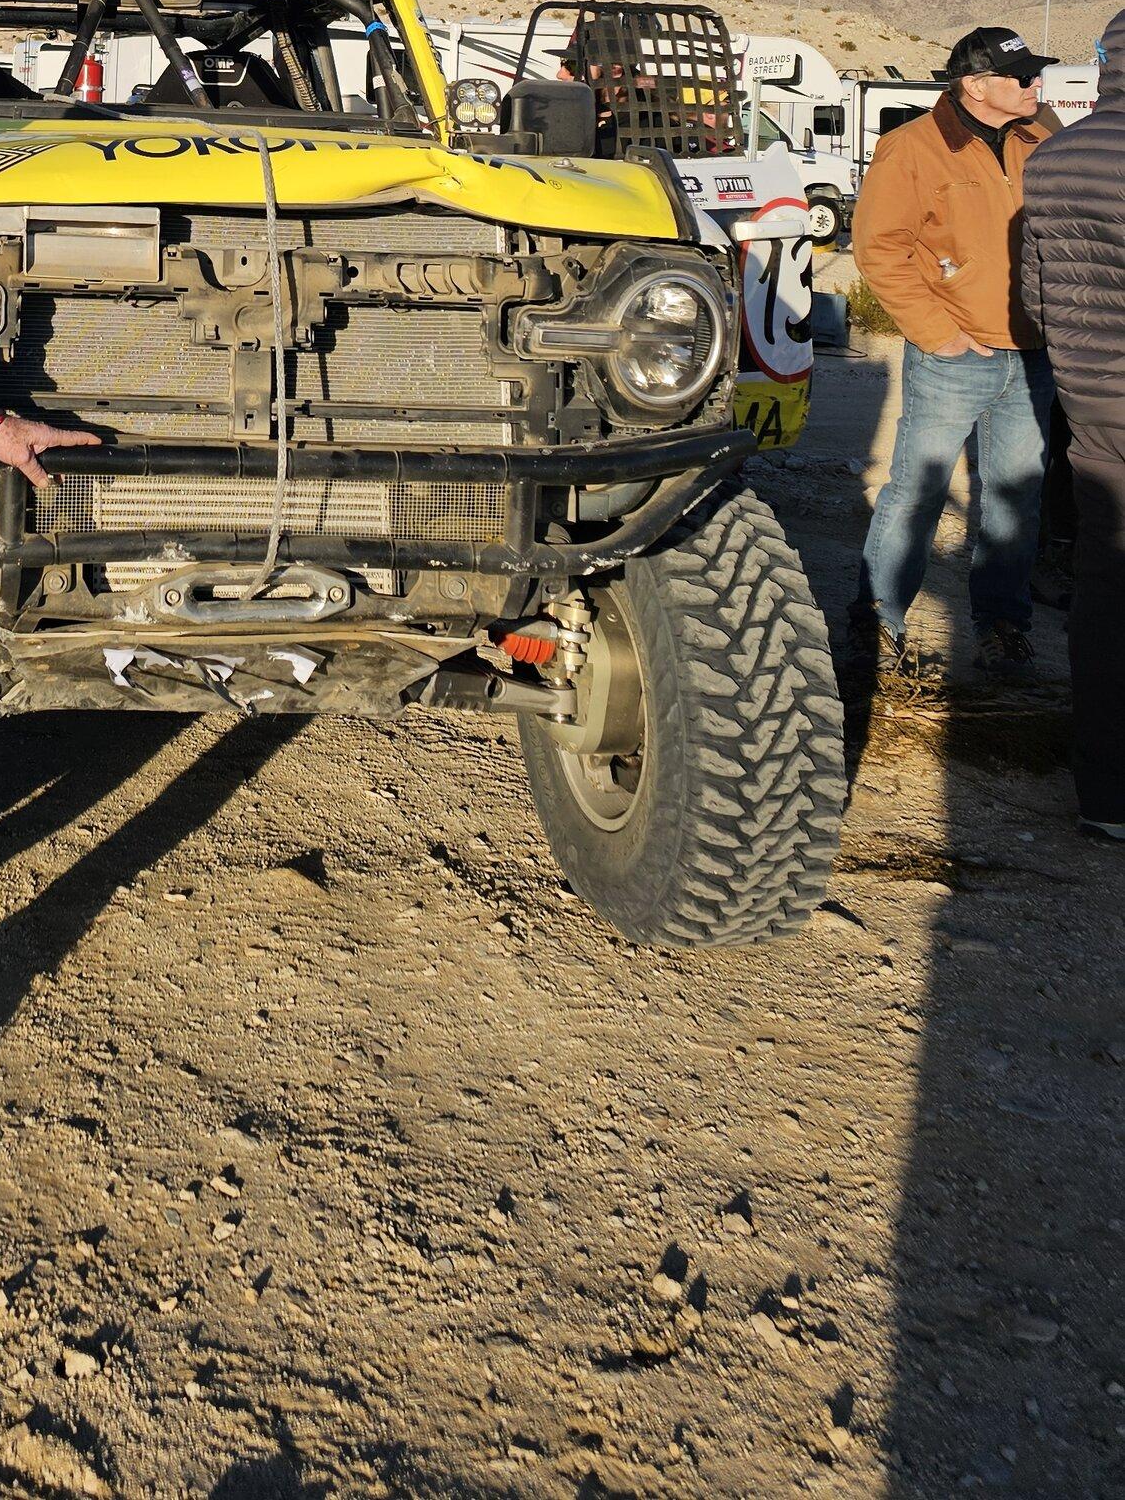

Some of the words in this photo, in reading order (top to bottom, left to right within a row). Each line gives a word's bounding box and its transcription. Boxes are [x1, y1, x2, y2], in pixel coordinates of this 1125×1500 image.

[204, 57, 235, 69] OMP
[748, 54, 791, 66] BADLANDS
[753, 64, 784, 75] STREET
[1058, 100, 1087, 109] MONTE
[715, 177, 753, 192] OPTIMA
